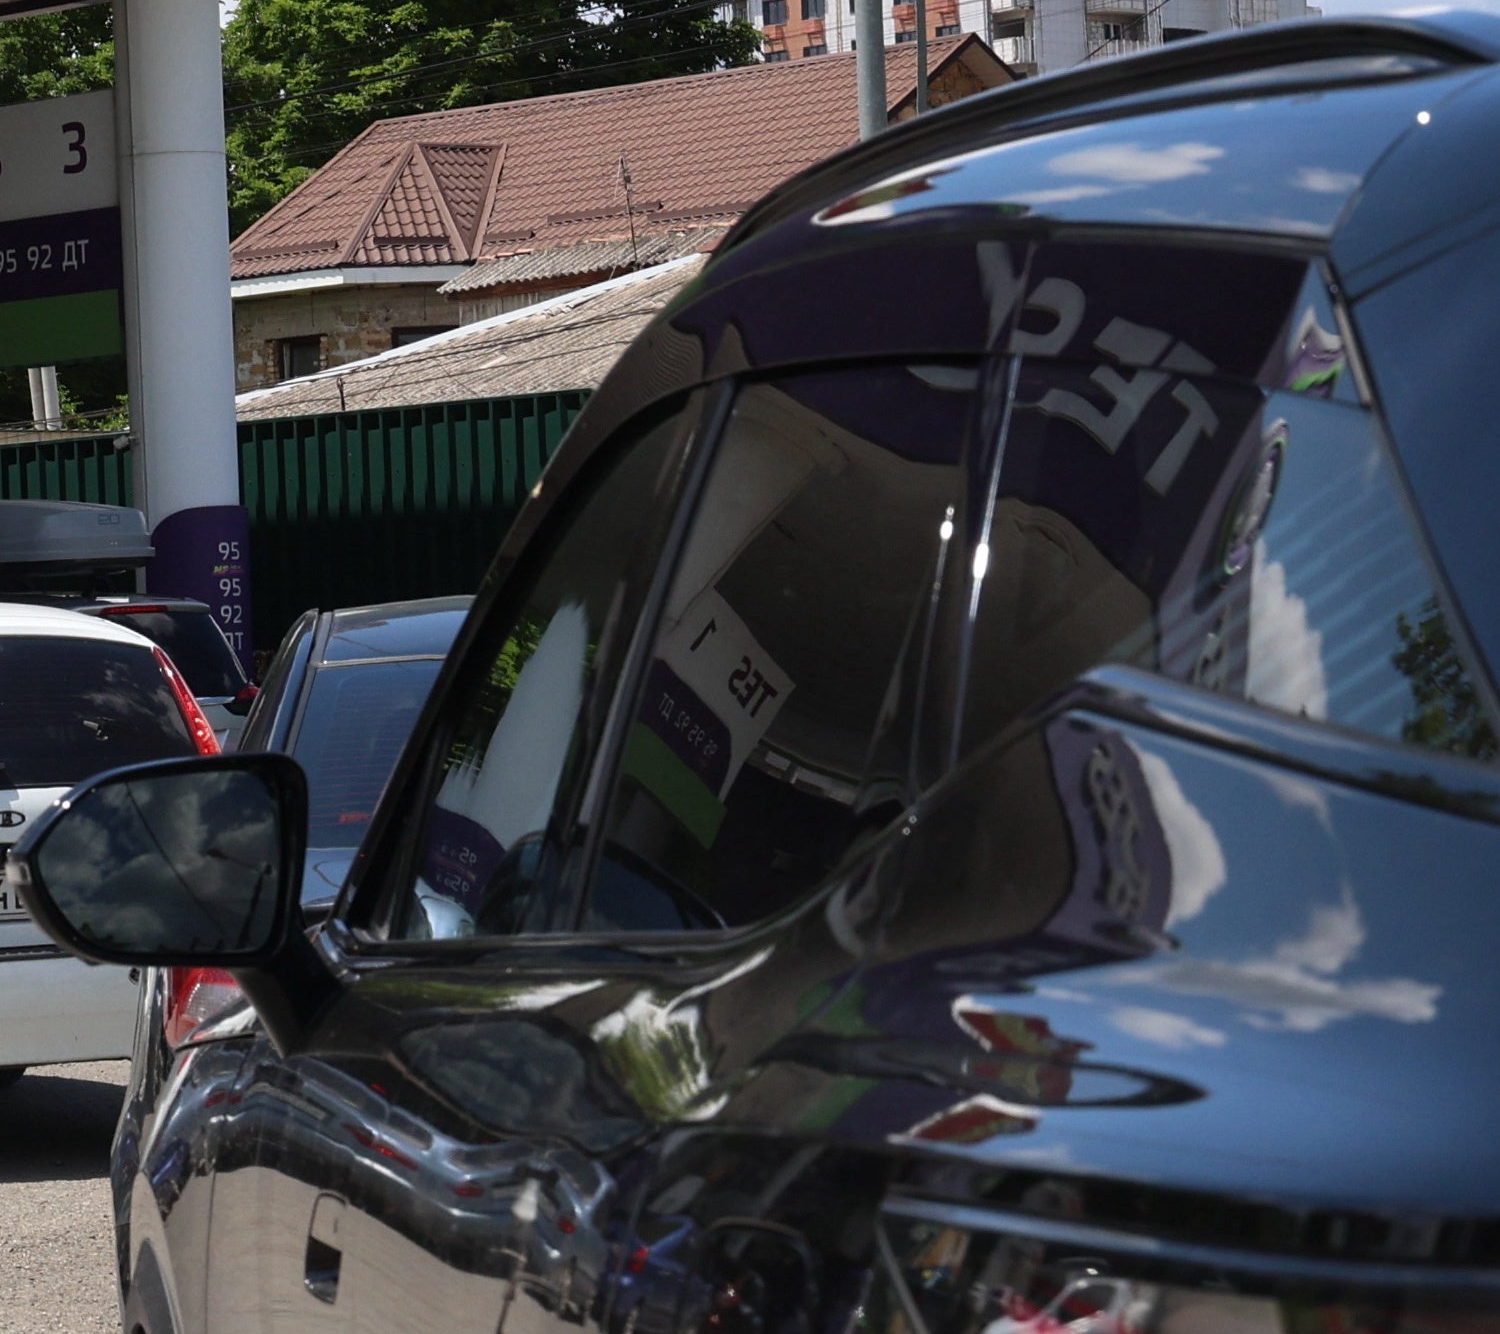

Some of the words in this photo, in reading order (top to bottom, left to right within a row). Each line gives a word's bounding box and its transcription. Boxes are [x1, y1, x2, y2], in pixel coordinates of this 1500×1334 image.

[61, 121, 88, 174] 3
[26, 244, 52, 270] 92
[61, 239, 89, 272] ДТ
[218, 541, 240, 560] 95
[219, 578, 242, 597] 95
[220, 605, 242, 624] 92
